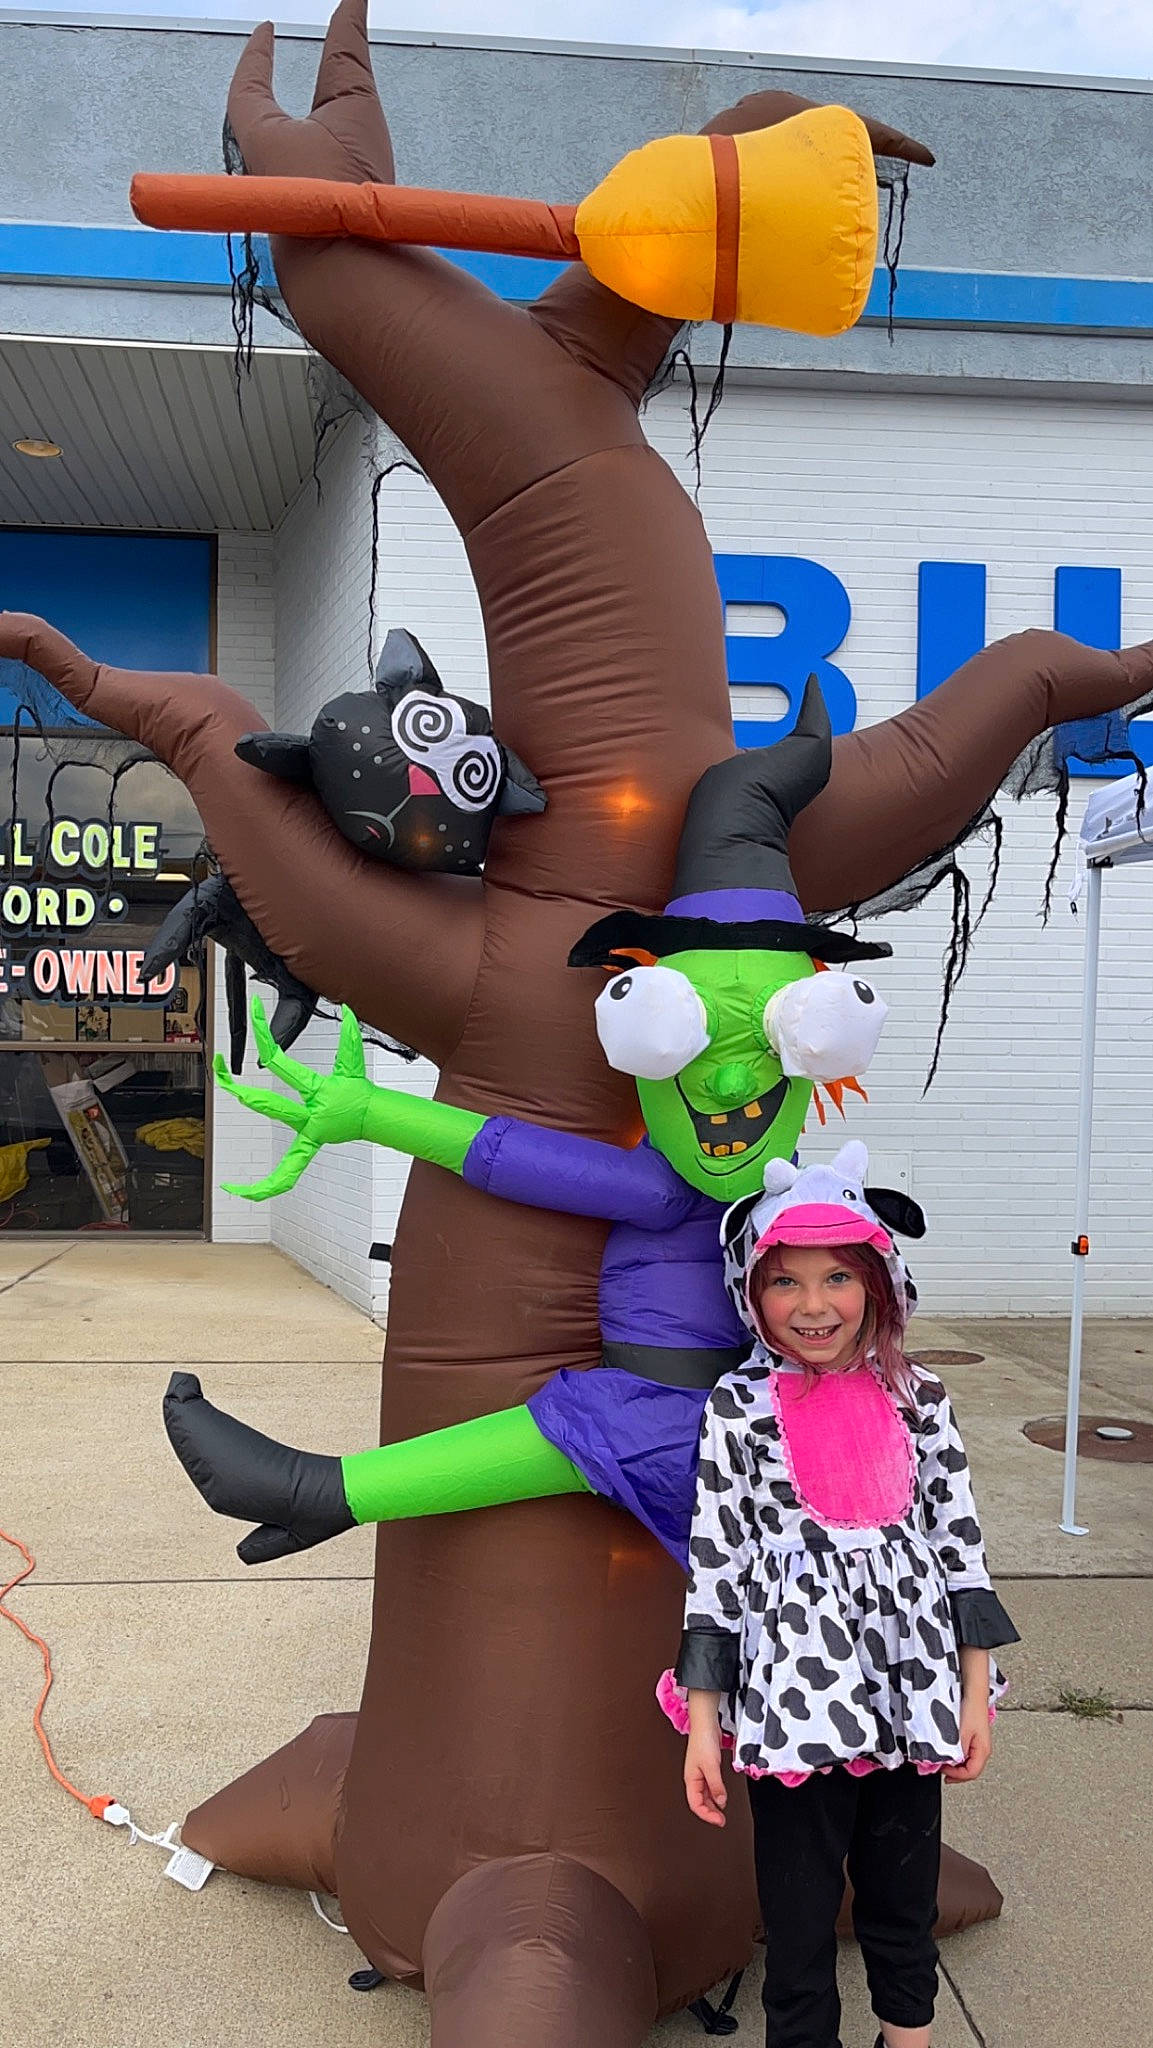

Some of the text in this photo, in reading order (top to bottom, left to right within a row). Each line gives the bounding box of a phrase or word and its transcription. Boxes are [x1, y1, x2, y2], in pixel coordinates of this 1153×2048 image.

[0, 820, 158, 869] L COLE
[2, 885, 96, 926] ORD
